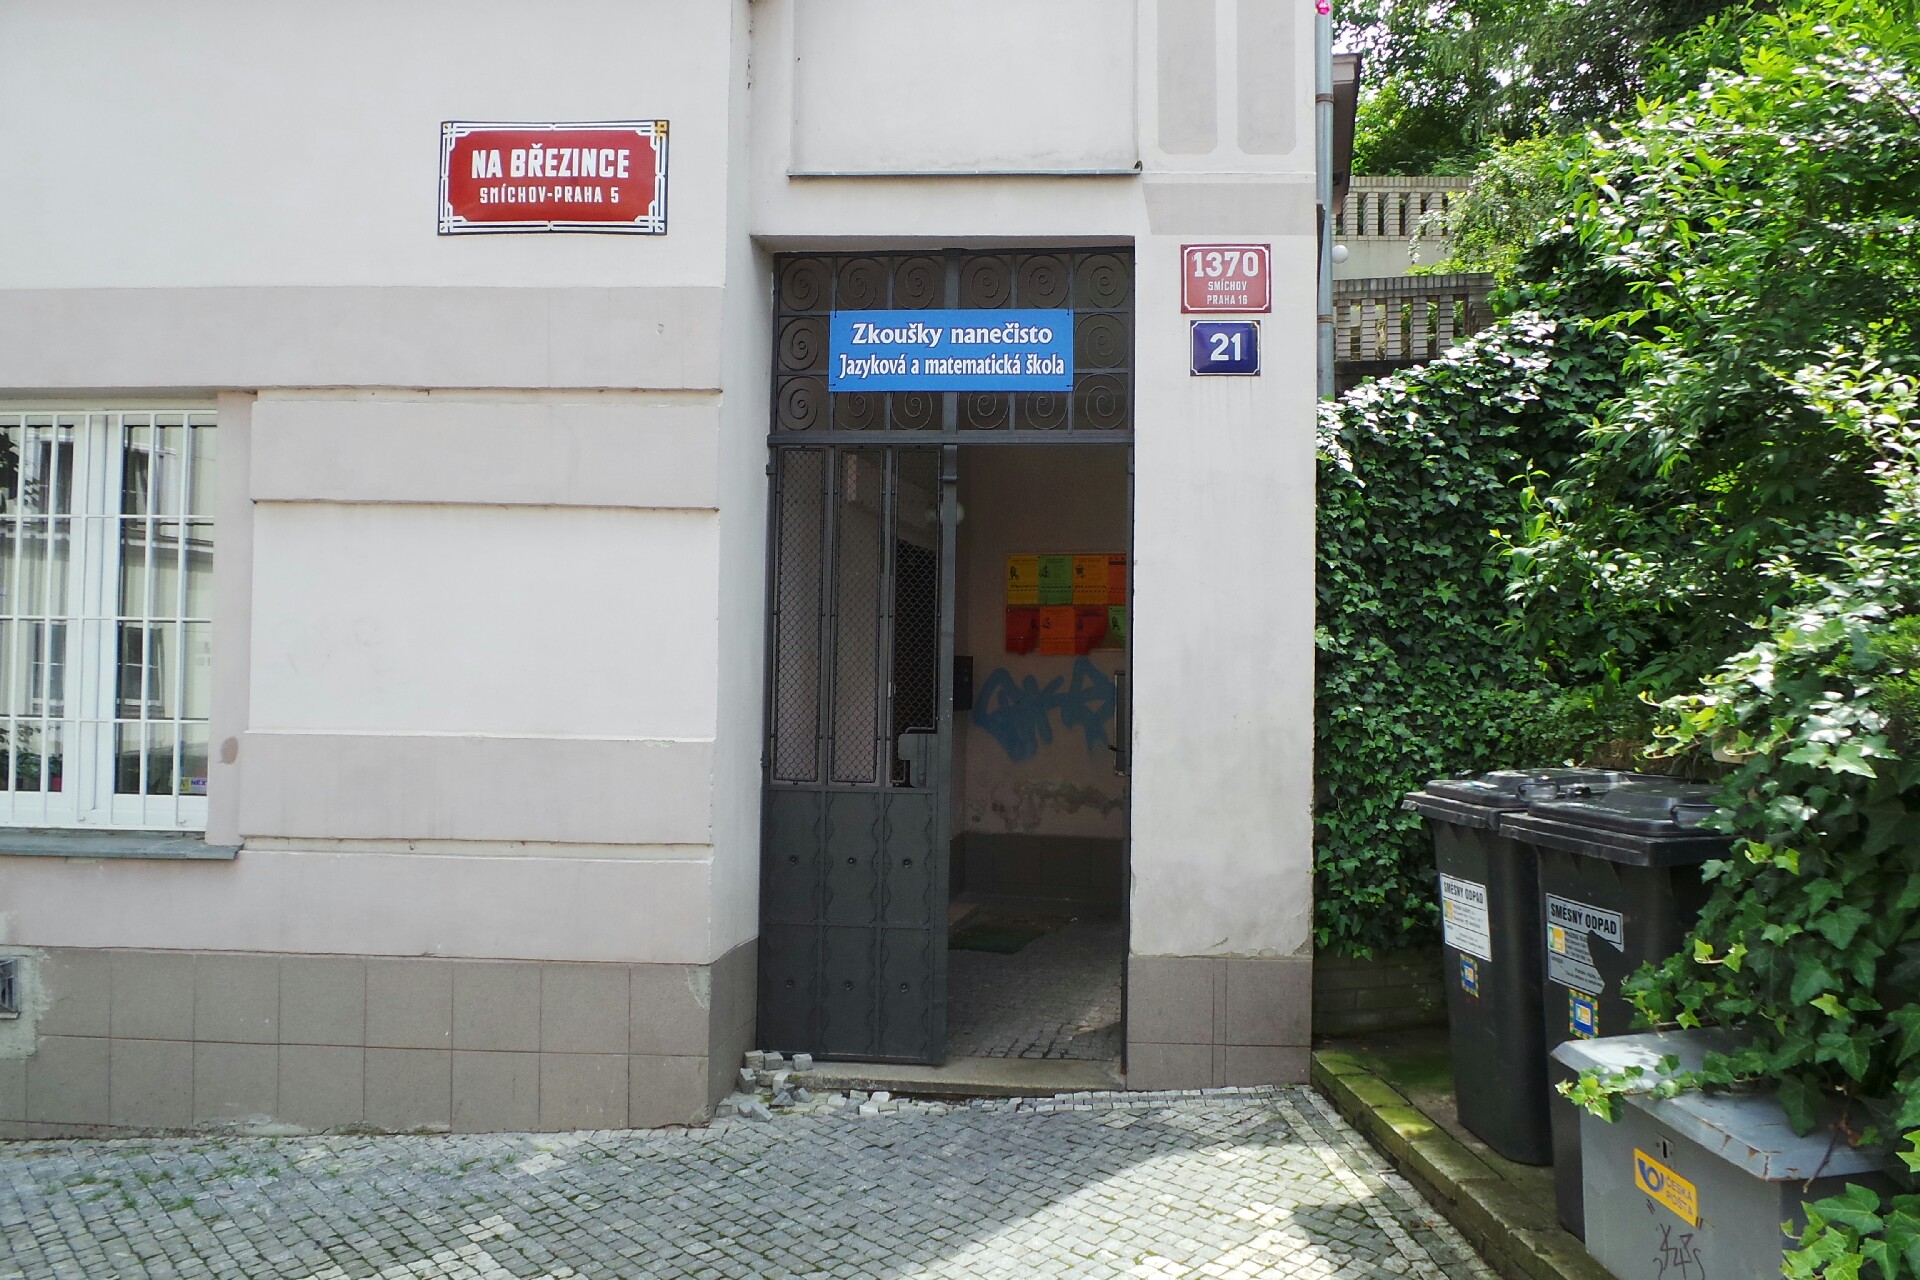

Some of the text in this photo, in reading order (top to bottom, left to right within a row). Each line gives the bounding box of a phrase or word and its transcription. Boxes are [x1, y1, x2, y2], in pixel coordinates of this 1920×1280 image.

[472, 143, 630, 178] NA BŘEZINCE
[479, 184, 619, 203] SMÍCHOV-PRAHA 5
[1192, 251, 1259, 277] 1370
[1208, 279, 1247, 291] SMÍCHOV
[1207, 295, 1236, 305] PRAHA
[851, 322, 1053, 347] Zkoušky nanečisto
[1210, 333, 1242, 361] 21
[838, 353, 1065, 379] Jazyková a matematická škola
[1464, 888, 1483, 904] ODPAD
[1551, 903, 1617, 935] SMĚSNÝ ODPAD
